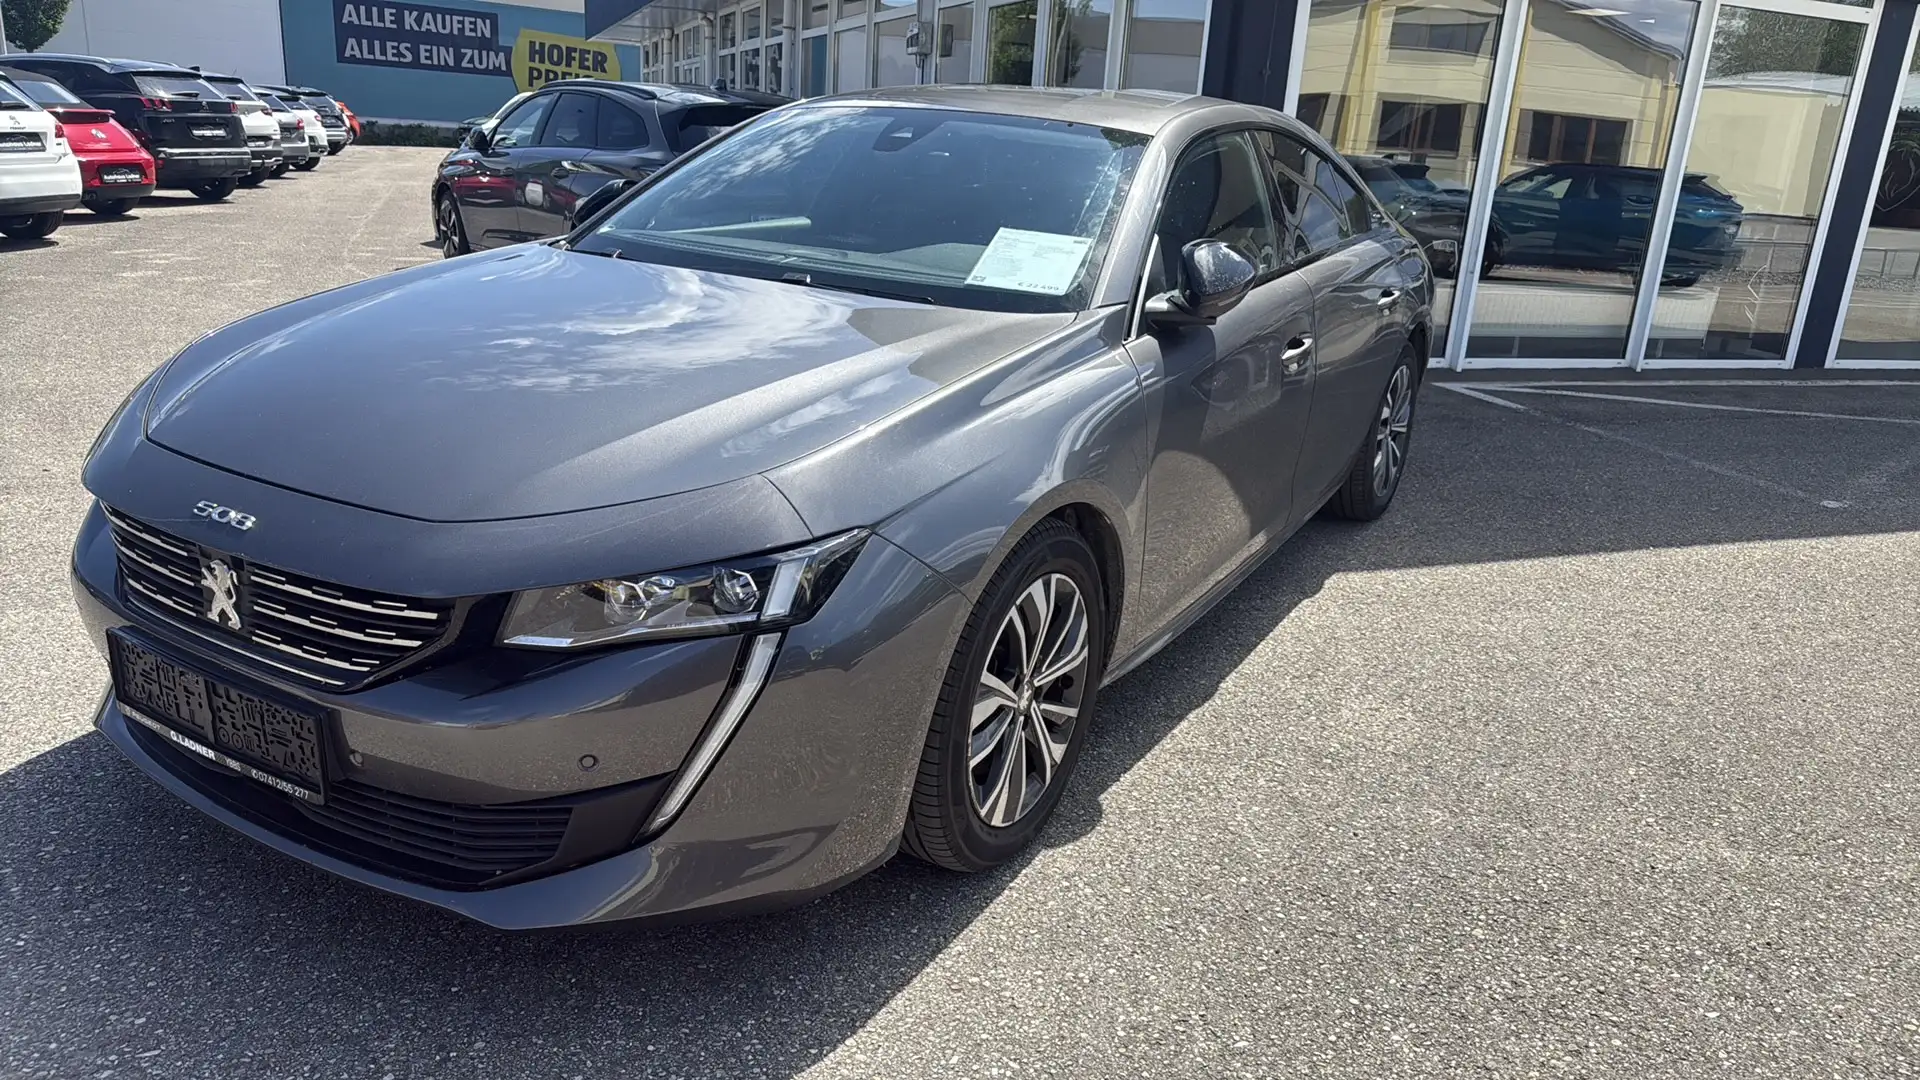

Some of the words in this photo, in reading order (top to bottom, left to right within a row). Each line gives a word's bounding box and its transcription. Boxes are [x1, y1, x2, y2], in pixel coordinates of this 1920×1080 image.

[341, 3, 397, 29] ALLE
[403, 11, 491, 39] KAUFEN
[344, 37, 413, 64] ALLES
[419, 44, 455, 68] EIN
[460, 48, 507, 72] ZUM
[528, 40, 608, 74] HOFER
[192, 500, 257, 531] 508
[169, 730, 216, 760] G.LADNER
